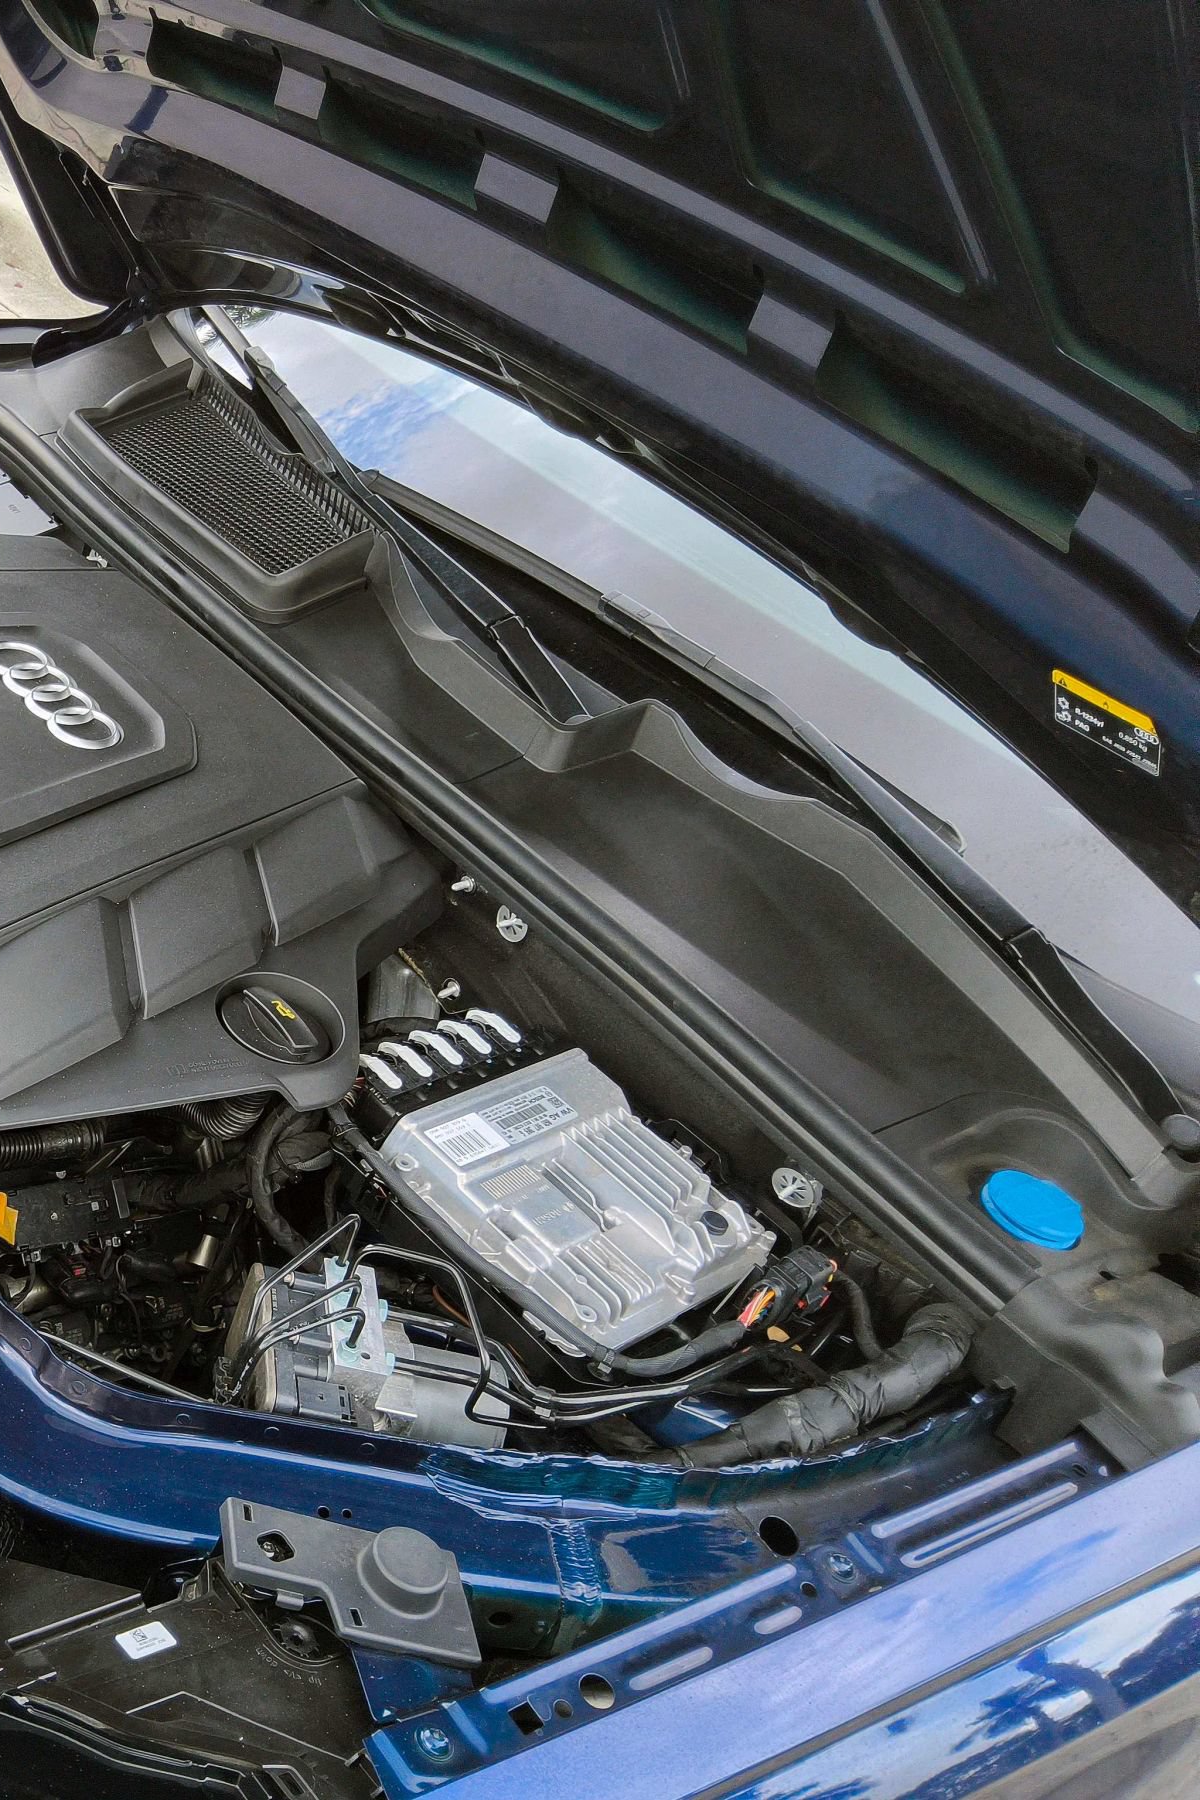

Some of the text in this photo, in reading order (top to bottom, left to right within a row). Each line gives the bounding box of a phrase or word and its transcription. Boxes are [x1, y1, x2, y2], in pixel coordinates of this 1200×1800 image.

[1139, 741, 1147, 752] kg
[561, 1107, 573, 1116] VW
[549, 1113, 561, 1121] AG
[255, 1647, 278, 1667] down
